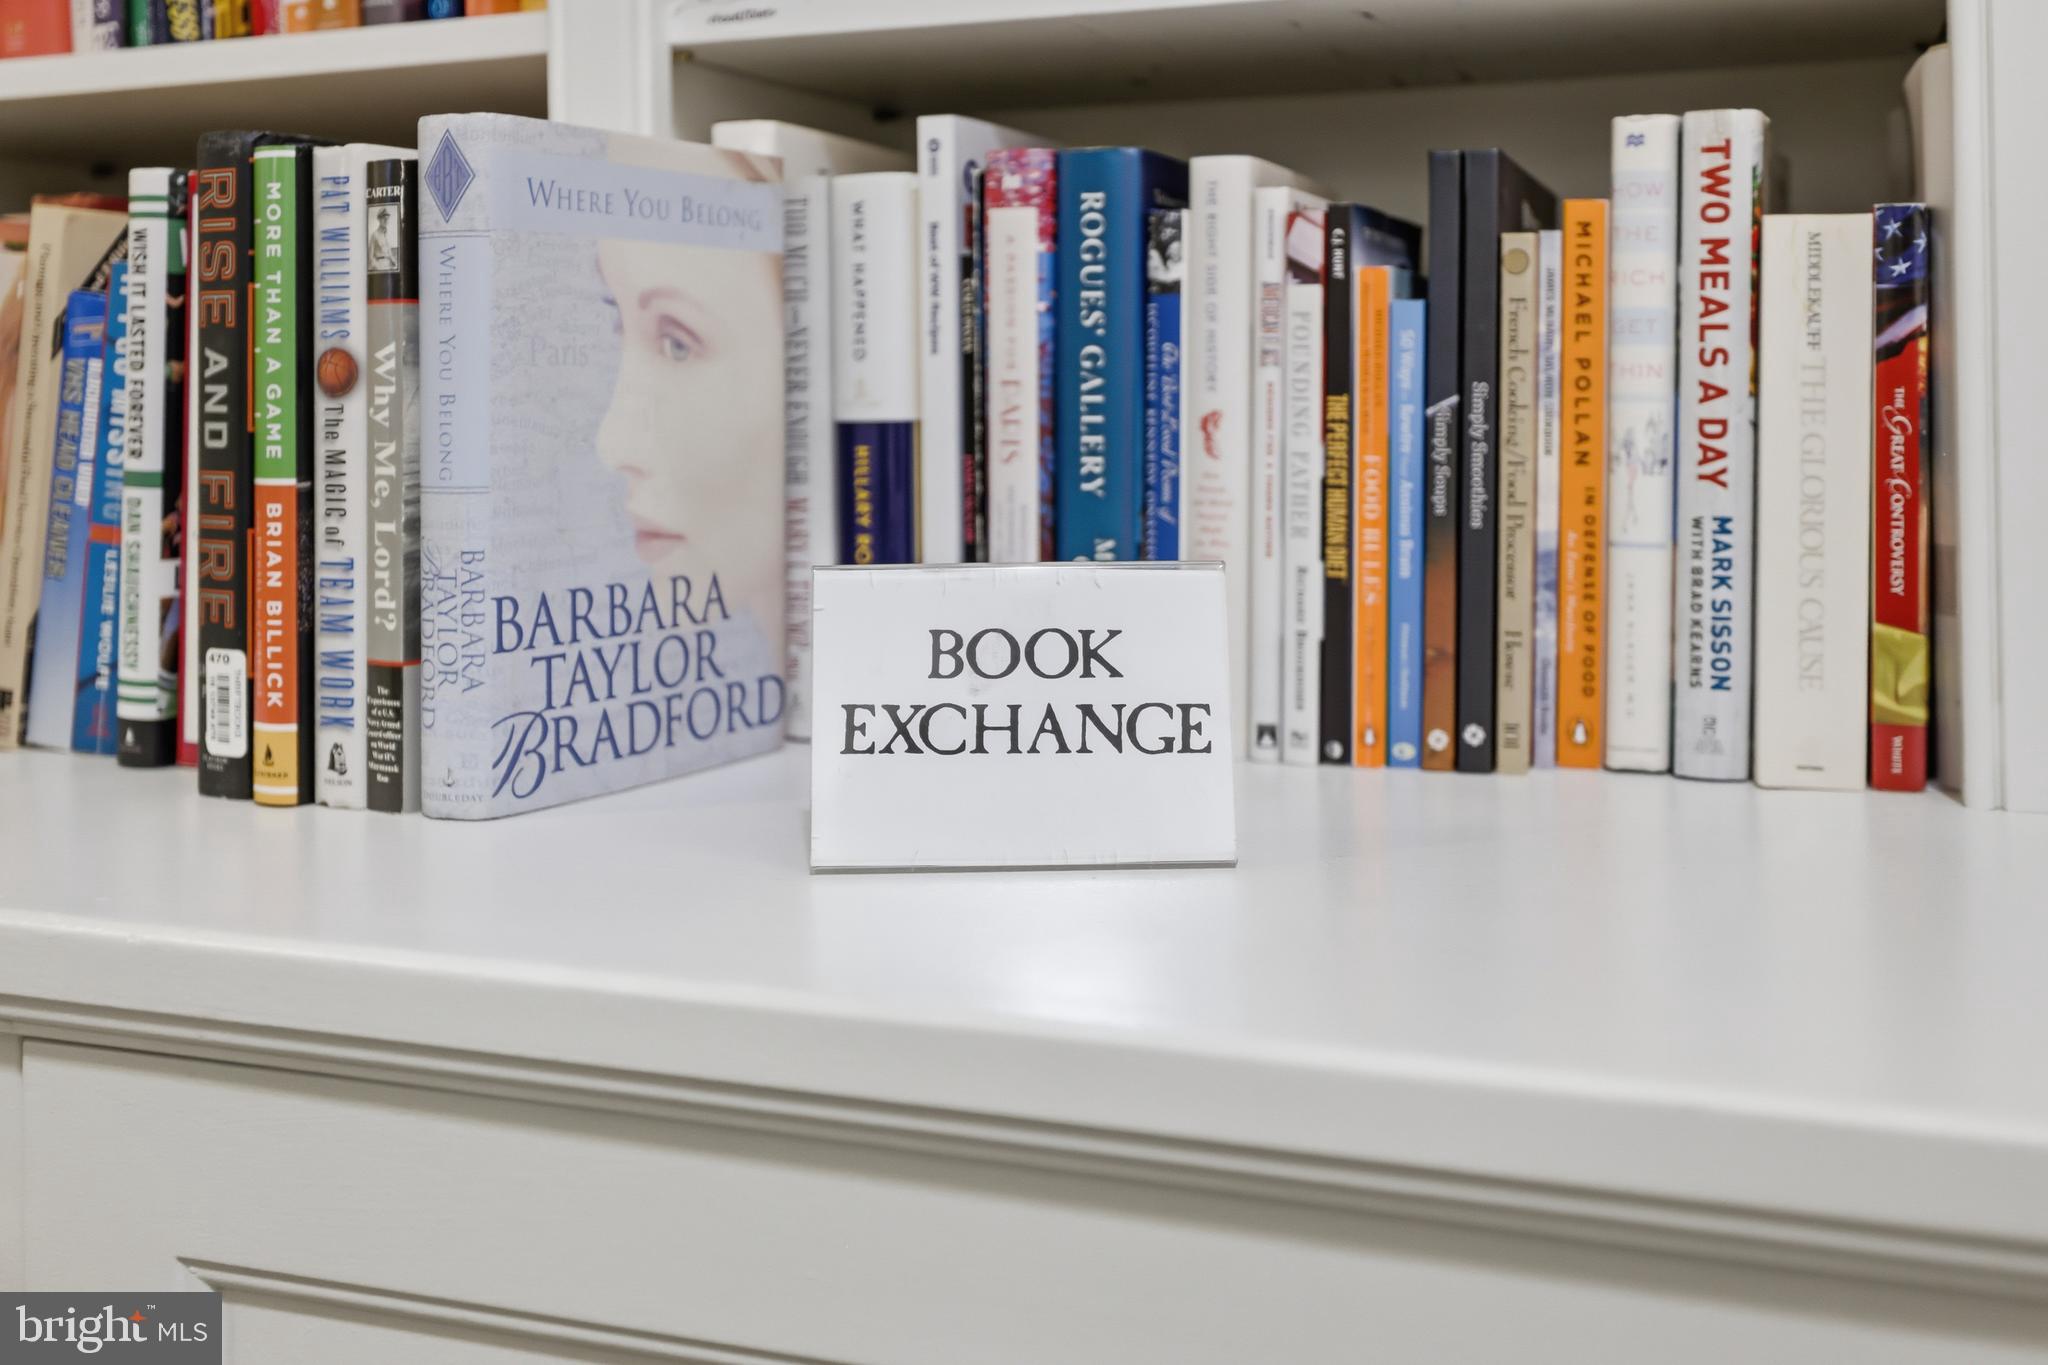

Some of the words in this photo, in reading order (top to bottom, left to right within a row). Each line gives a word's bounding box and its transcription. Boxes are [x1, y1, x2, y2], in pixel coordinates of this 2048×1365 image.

[321, 176, 350, 213] PAT
[366, 185, 402, 199] CARTER
[527, 176, 614, 216] WHERE
[623, 188, 669, 221] YOU
[681, 195, 763, 231] BELONG
[1701, 139, 1731, 224] TWO
[132, 229, 147, 273] WISH
[199, 167, 237, 329] RISE
[266, 182, 281, 258] MORE
[852, 200, 866, 253] WHAT
[131, 283, 146, 297] IT
[320, 227, 350, 339] WILLIAMS
[438, 244, 457, 326] WHERE
[1079, 191, 1107, 337] ROGUES'
[1575, 221, 1593, 343] MICHAEL
[1806, 231, 1822, 351] MIDDLEKAUFF
[129, 306, 146, 371] LASTED
[266, 271, 281, 344] THAN
[852, 263, 868, 362] HAPPENED
[1507, 297, 1528, 360] French
[1699, 238, 1730, 367] MEALS
[266, 357, 281, 374] A
[370, 341, 396, 428] Why
[438, 334, 457, 381] YOU
[1698, 380, 1728, 404] A
[1800, 356, 1826, 426] THE
[128, 380, 144, 460] FOREVER
[204, 347, 229, 450] AND
[266, 384, 282, 458] GAME
[324, 403, 344, 440] The
[1079, 344, 1105, 498] GALLERY
[1326, 394, 1349, 422] THE
[1431, 407, 1452, 463] Simply
[1469, 382, 1490, 439] Simply
[1573, 357, 1592, 466] POLLAN
[1894, 386, 1905, 409] THE
[370, 440, 396, 508] Me,
[438, 393, 457, 482] BELONG
[1325, 422, 1349, 486] PERFECT
[1697, 418, 1728, 490] DAY
[1882, 405, 1913, 474] GREAT
[324, 450, 347, 518] MAGIC
[853, 444, 872, 528] HILLARY
[1325, 488, 1348, 543] HUMAN
[1470, 442, 1488, 530] Smoothies
[1584, 486, 1597, 506] IN
[1798, 433, 1826, 588] GLORIOUS
[199, 470, 235, 630] FIRE
[266, 502, 282, 588] BRIAN
[324, 526, 347, 547] of
[1325, 546, 1348, 580] DIET
[1504, 514, 1524, 599] Processor
[1582, 515, 1596, 602] DEFENSE
[1691, 516, 1704, 560] WITH
[1711, 515, 1733, 591] MARK
[1884, 478, 1912, 596] CONTROVERSY
[319, 557, 355, 634] TEAM
[374, 520, 396, 631] Lord?
[491, 571, 731, 655] BARBARA
[1689, 567, 1703, 613] BRAD
[266, 600, 284, 709] BILLICK
[420, 536, 441, 730] BRADFORD
[437, 569, 458, 689] TAYLOR
[460, 550, 485, 694] BARBARA
[928, 627, 1124, 680] BOOK
[1582, 611, 1596, 637] OF
[1689, 619, 1703, 690] KEARNS
[1710, 599, 1732, 692] SISSON
[1798, 598, 1825, 691] CAUSE
[319, 650, 355, 730] WORK
[531, 629, 725, 712] TAYLOR
[1582, 645, 1596, 700] FOOD
[491, 673, 787, 799] BRADFORD
[839, 702, 1212, 755] EXCHANGE
